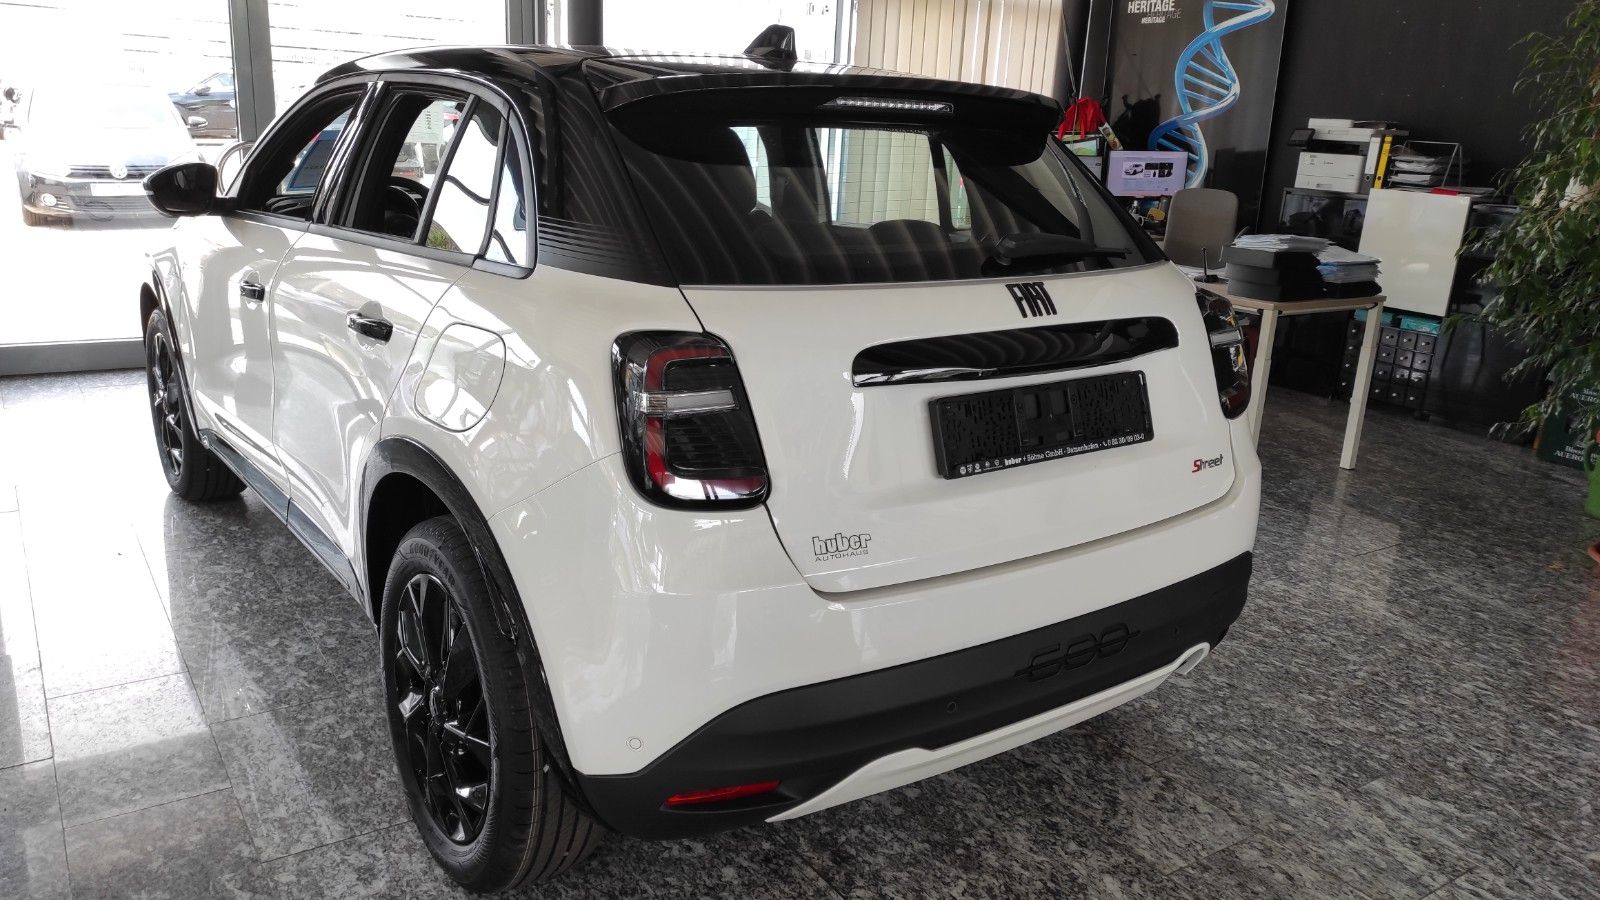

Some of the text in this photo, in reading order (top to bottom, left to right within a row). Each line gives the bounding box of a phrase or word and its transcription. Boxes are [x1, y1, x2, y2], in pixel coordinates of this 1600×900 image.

[1128, 0, 1176, 13] HERITAGE
[1141, 16, 1166, 24] HERITAGE
[1005, 282, 1057, 318] FIAT
[1045, 448, 1063, 458] GmbH
[1192, 454, 1223, 473] Street
[812, 532, 872, 556] huber
[815, 549, 869, 562] AUTOHAUS
[1026, 622, 1131, 682] 600
